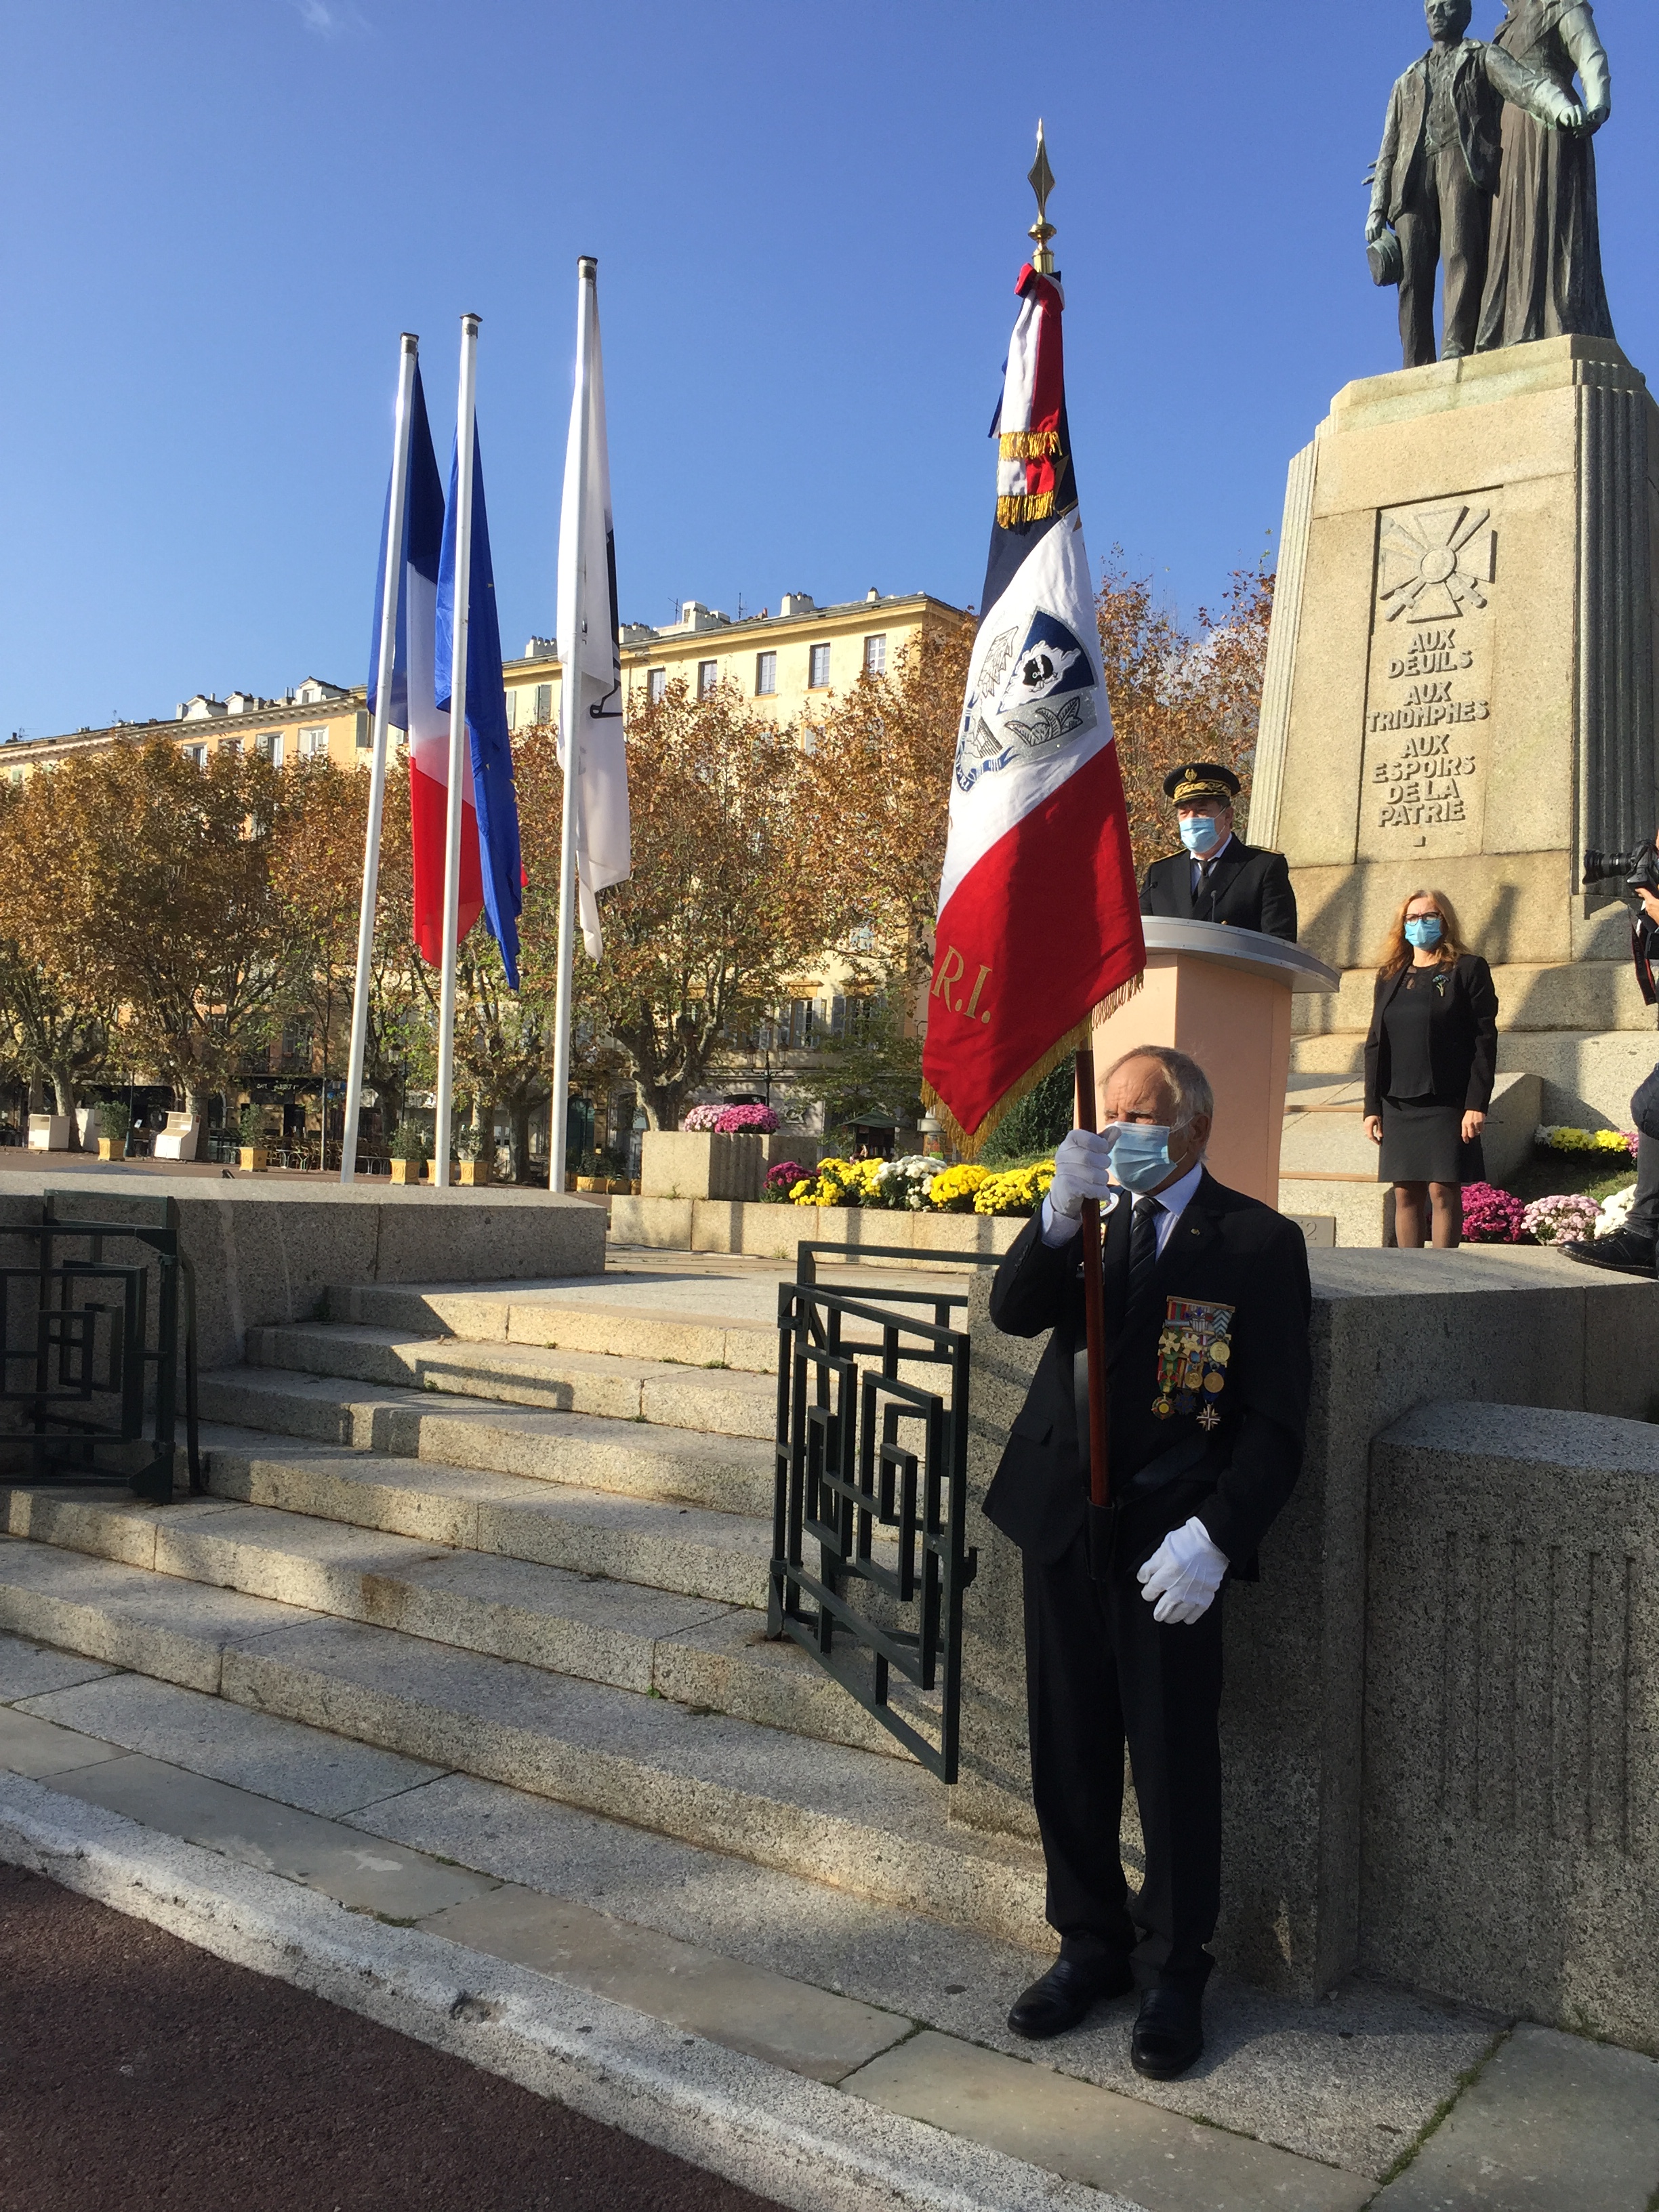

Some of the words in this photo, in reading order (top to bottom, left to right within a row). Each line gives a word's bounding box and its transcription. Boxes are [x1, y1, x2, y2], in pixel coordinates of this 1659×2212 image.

[1408, 628, 1456, 654] AUX
[1388, 650, 1473, 678] DEUILS
[1404, 681, 1452, 706] AUX
[1366, 699, 1490, 733] TRIOMPHES
[1400, 734, 1450, 758] AUX
[1372, 756, 1476, 783] ESPOIRS
[1386, 781, 1420, 804] DE
[1424, 778, 1460, 801] LA
[1378, 799, 1466, 827] PATRIE
[930, 945, 992, 1024] R.I.
